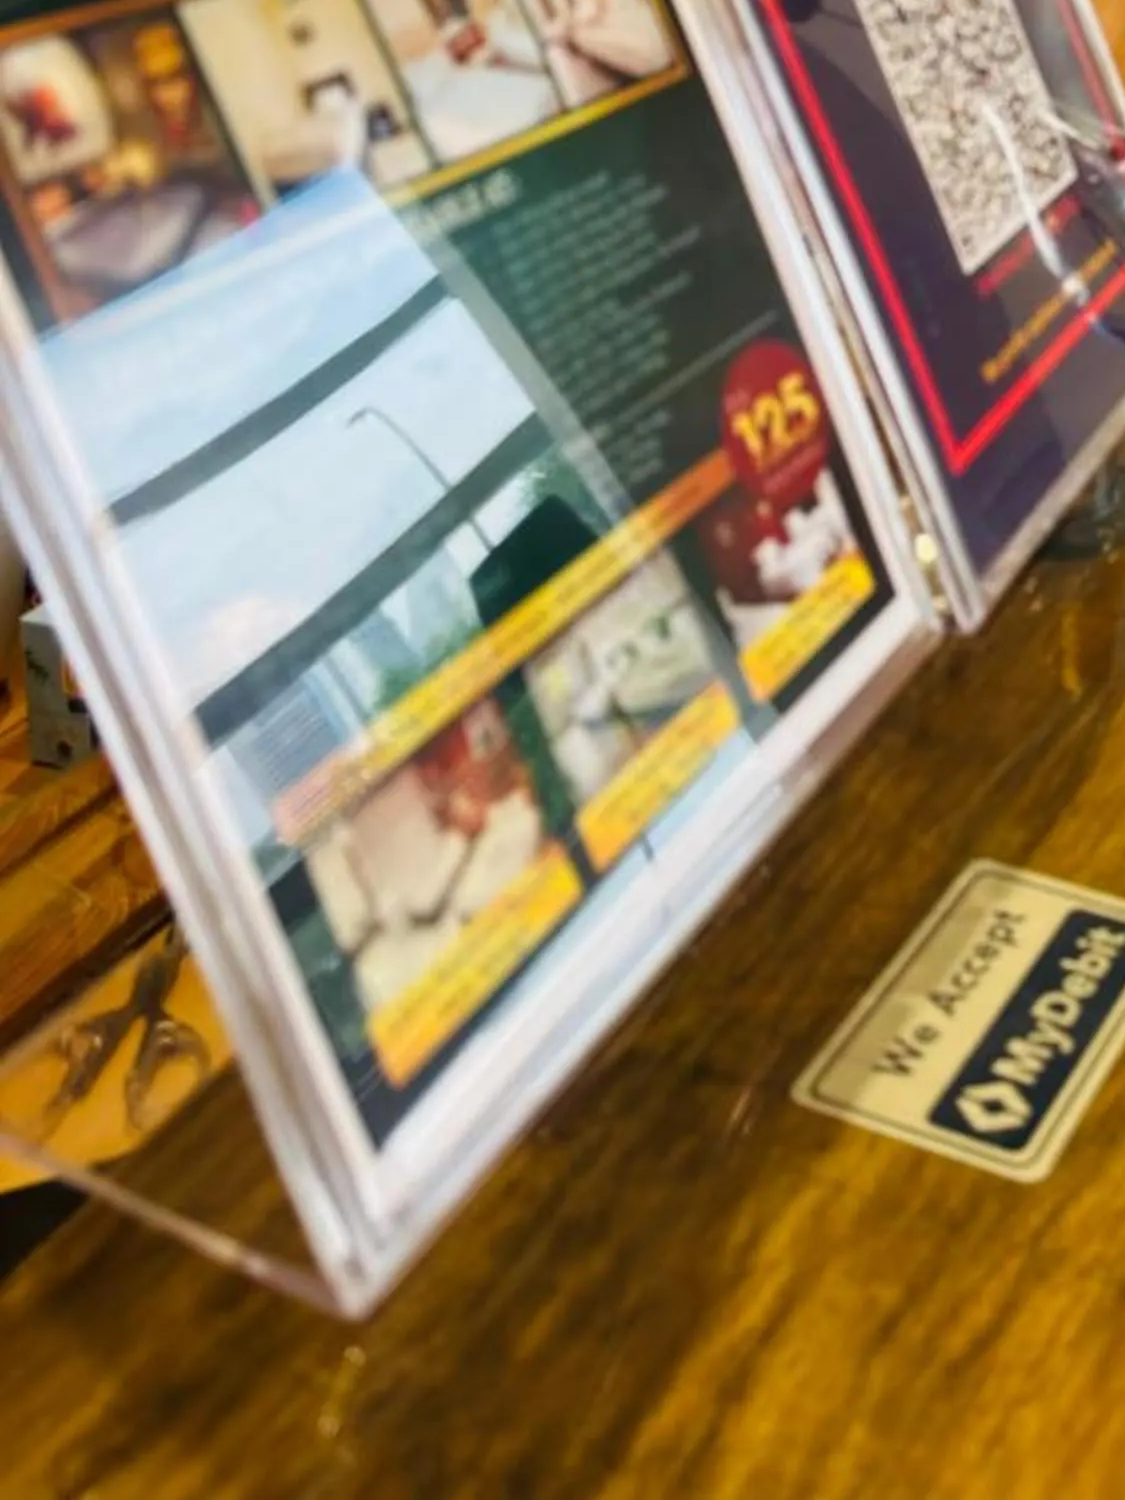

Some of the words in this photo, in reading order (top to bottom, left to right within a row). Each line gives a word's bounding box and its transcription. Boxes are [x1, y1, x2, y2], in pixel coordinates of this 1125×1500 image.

[731, 371, 820, 474] 125
[869, 1023, 941, 1080] We
[924, 908, 1026, 1019] Accept
